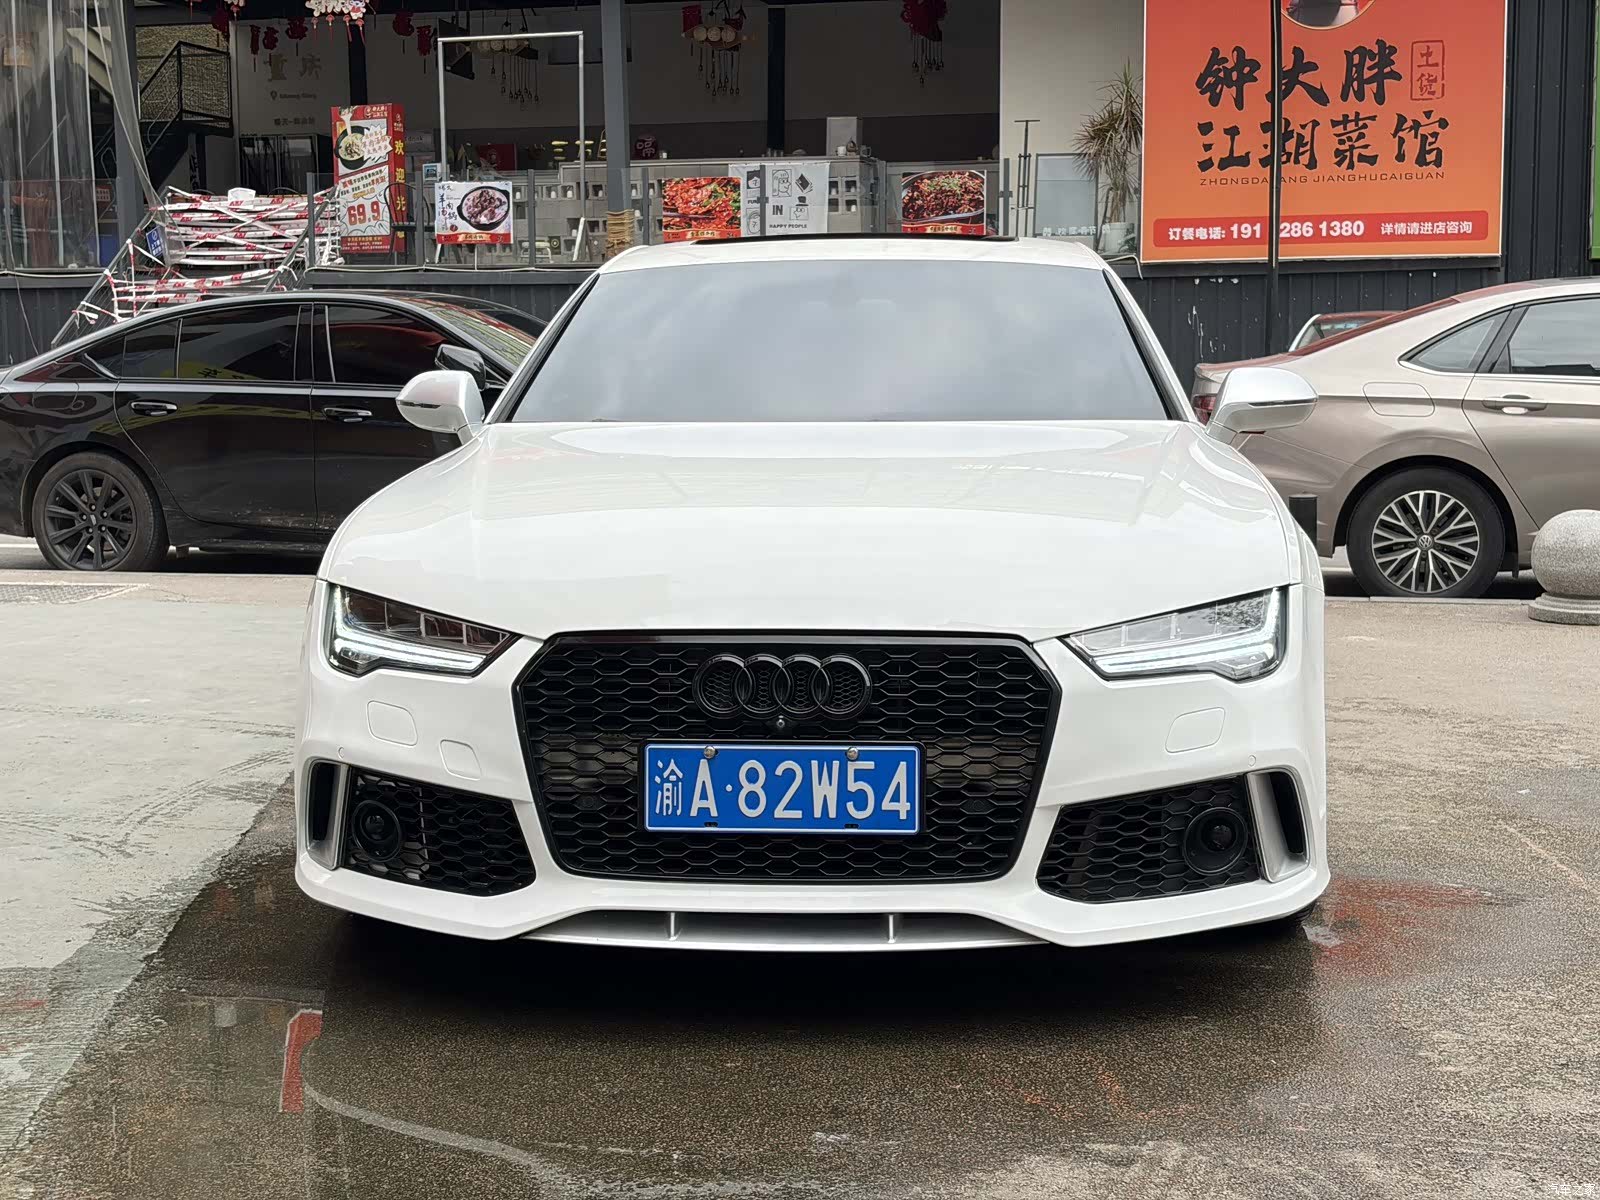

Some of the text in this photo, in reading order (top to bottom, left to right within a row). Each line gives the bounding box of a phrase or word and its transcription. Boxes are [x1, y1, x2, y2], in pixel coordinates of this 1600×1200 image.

[1195, 39, 1402, 111] 钟大胖
[1416, 45, 1438, 97] 土货
[1196, 110, 1449, 172] 江湖菜馆
[1200, 171, 1445, 186] ZHONGDAANG JIANGHUCAIGUAN
[347, 200, 381, 226] 69.9
[772, 204, 784, 216] IN
[1168, 220, 1365, 240] 订餐电话: 191 286 1380
[1380, 221, 1473, 236] 详情请进店咨询
[655, 758, 911, 820] 渝A·82W54
